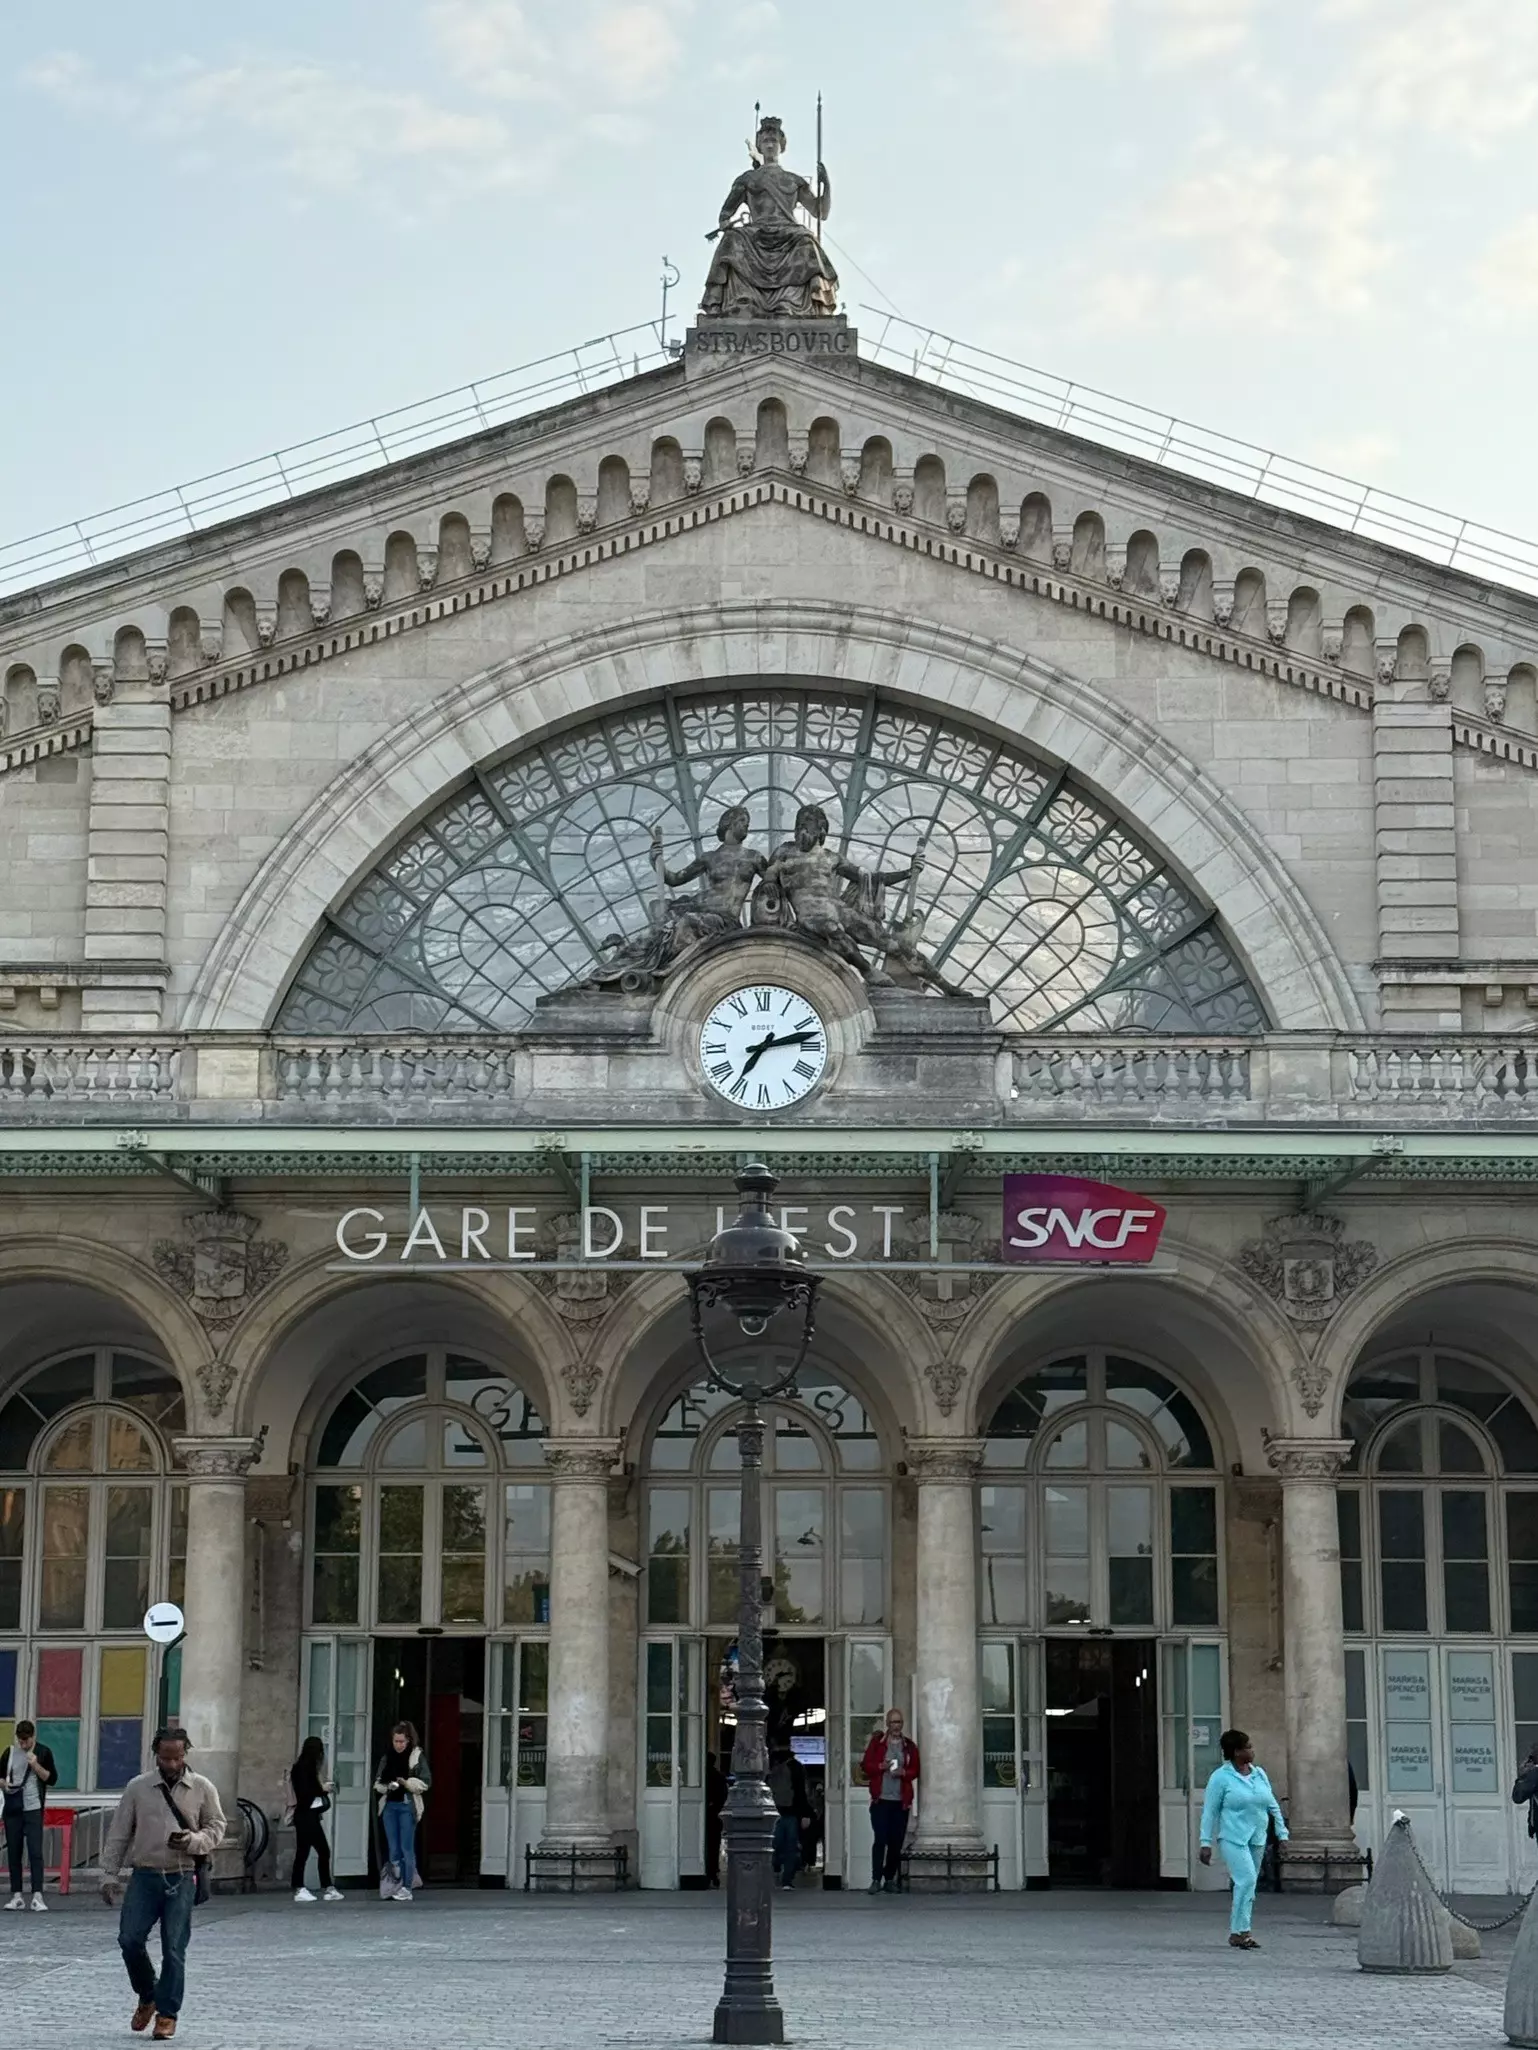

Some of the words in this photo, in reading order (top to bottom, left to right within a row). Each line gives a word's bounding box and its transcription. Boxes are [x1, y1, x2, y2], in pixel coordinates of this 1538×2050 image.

[697, 332, 850, 353] STRASBOVRG
[754, 991, 771, 1012] XII
[780, 997, 793, 1017] I
[711, 1016, 732, 1033] X
[793, 1016, 814, 1031] II
[800, 1041, 820, 1052] III
[710, 1060, 734, 1084] VIII
[757, 1083, 771, 1104] VI
[782, 1079, 796, 1098] V
[336, 1206, 537, 1259] GARE
[583, 1206, 668, 1258] DE
[1009, 1207, 1156, 1248] SNCF
[1452, 1676, 1482, 1684] MARKS
[1387, 1685, 1427, 1693] SPENCER
[1451, 1686, 1491, 1694] SPENCER
[1391, 1746, 1421, 1754] MARKS
[1455, 1747, 1485, 1755] MARKS
[1390, 1755, 1429, 1764] SPENCER
[1454, 1757, 1494, 1765] SPENCER
